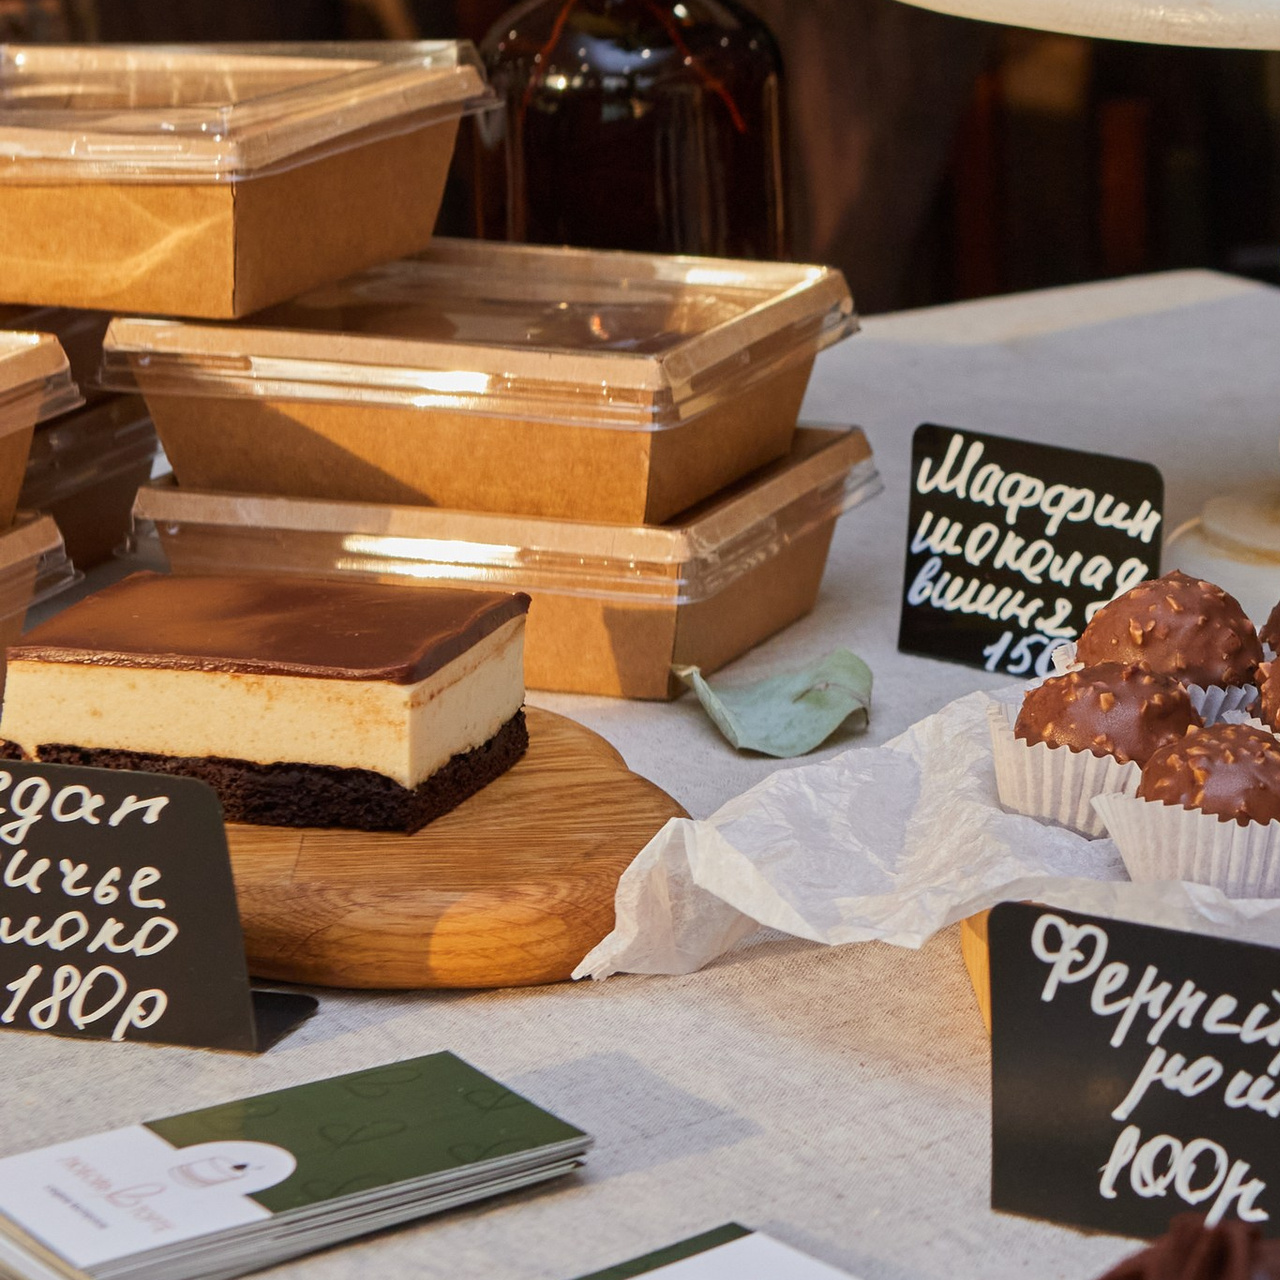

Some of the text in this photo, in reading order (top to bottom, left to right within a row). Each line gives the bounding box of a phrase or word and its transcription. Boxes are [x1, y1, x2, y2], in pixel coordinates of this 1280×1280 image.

[917, 434, 1162, 544] Маффин
[910, 510, 1149, 623] шоколад
[1099, 1125, 1269, 1230] 100р
